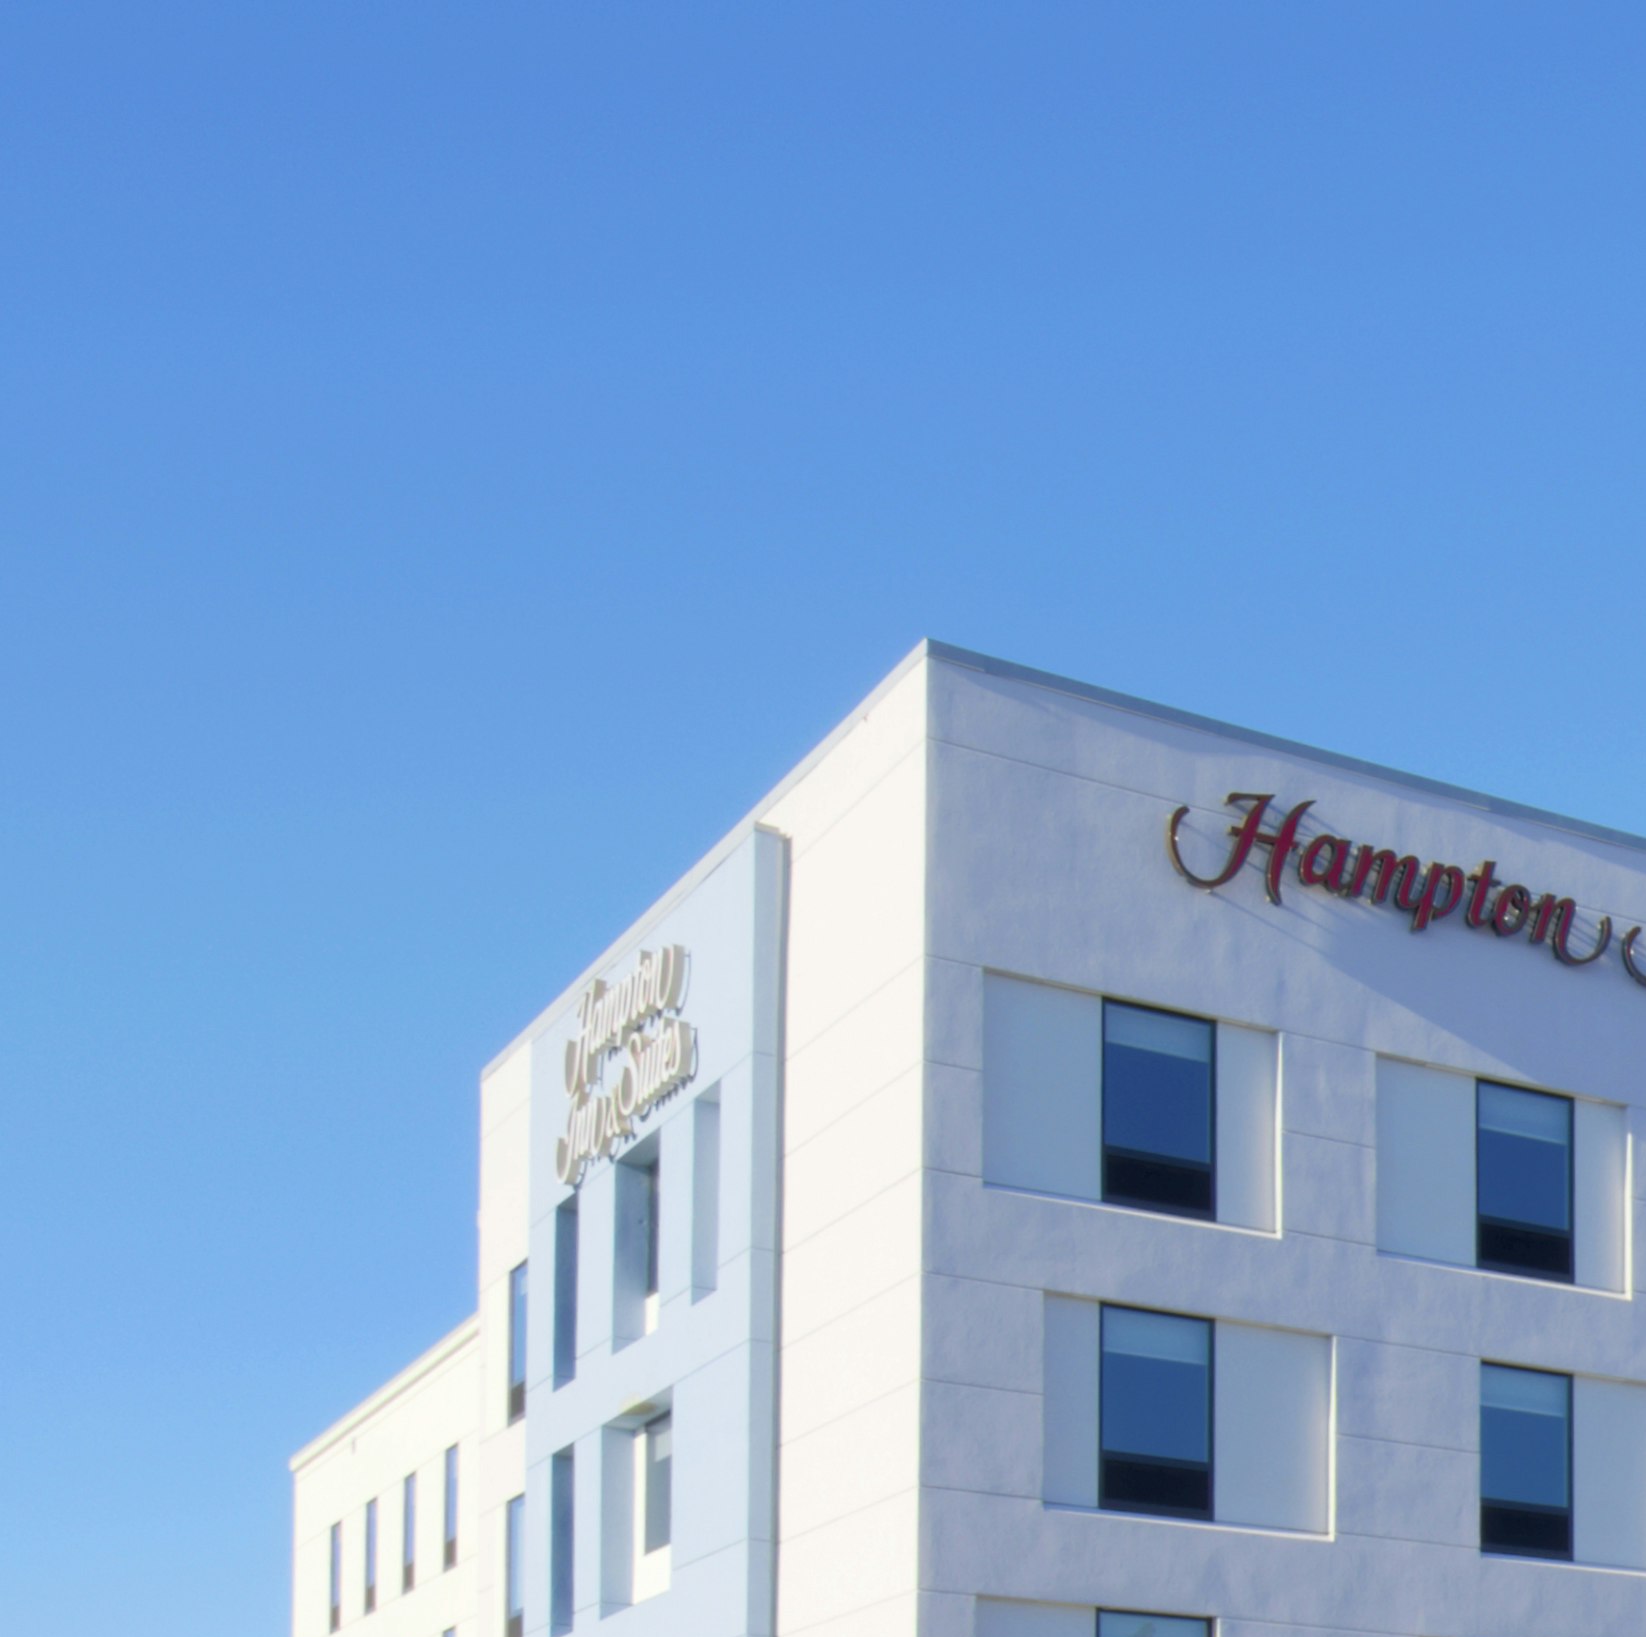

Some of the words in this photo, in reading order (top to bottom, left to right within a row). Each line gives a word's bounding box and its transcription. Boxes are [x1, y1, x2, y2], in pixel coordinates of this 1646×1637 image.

[1166, 792, 1611, 966] Hampton
[556, 1090, 612, 1186] Inn
[617, 1016, 690, 1117] Suites
[564, 943, 686, 1098] Hampton
